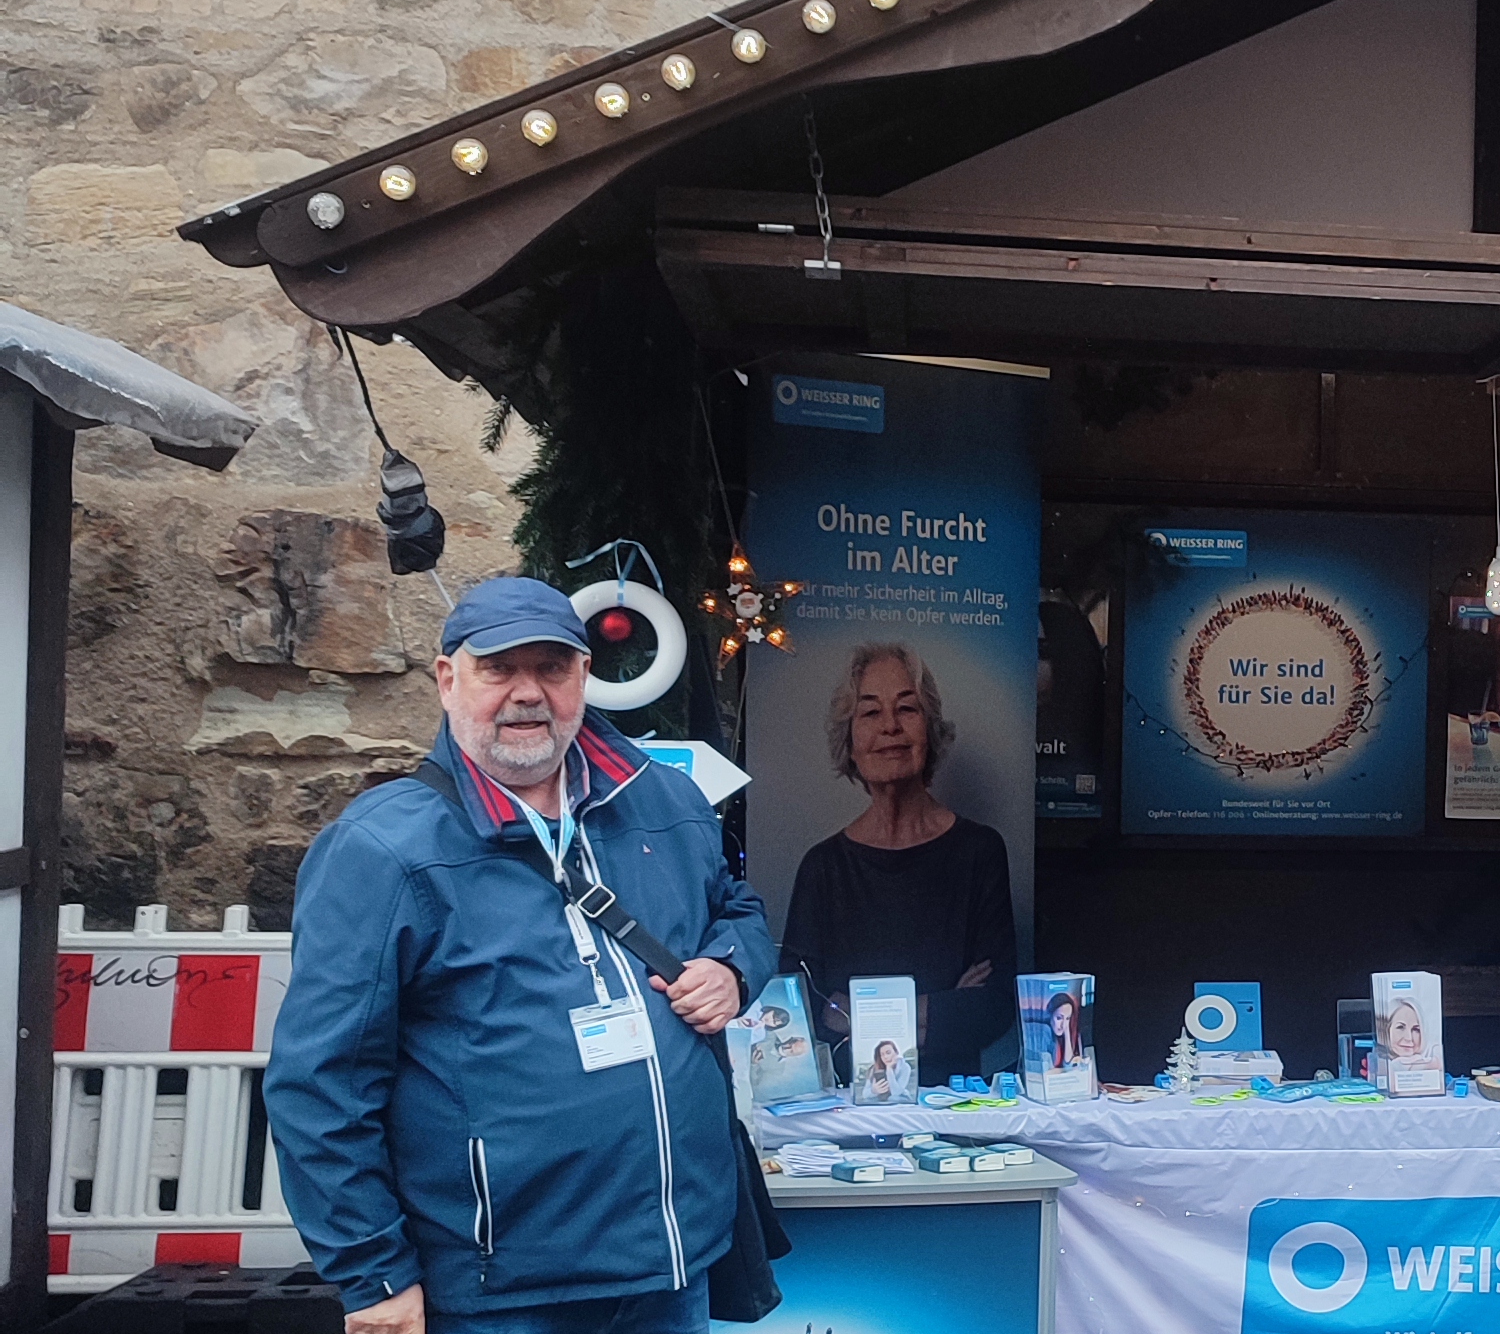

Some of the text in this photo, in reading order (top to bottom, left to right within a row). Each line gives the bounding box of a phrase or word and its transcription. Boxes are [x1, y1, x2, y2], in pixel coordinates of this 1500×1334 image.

[801, 388, 880, 409] WEISSER RING
[817, 504, 987, 543] Ohne Furcht
[1169, 537, 1243, 549] WEISSER RING
[846, 542, 957, 577] im Alter
[822, 583, 858, 598] mehr
[865, 584, 936, 602] Sicherheit
[940, 587, 958, 603] im
[963, 588, 1009, 609] Alltag,
[796, 602, 1004, 626] damit Sie kein Opfer werden.
[1229, 657, 1324, 678] Wir sind
[1218, 684, 1336, 706] für Sie da!
[1222, 799, 1270, 808] Bundesweit
[1272, 799, 1284, 808] für
[1287, 799, 1299, 808] Sie
[1317, 799, 1331, 808] Ort
[1147, 810, 1210, 820] Opfer-Telefon:
[1252, 810, 1319, 821] Onlineberatung:
